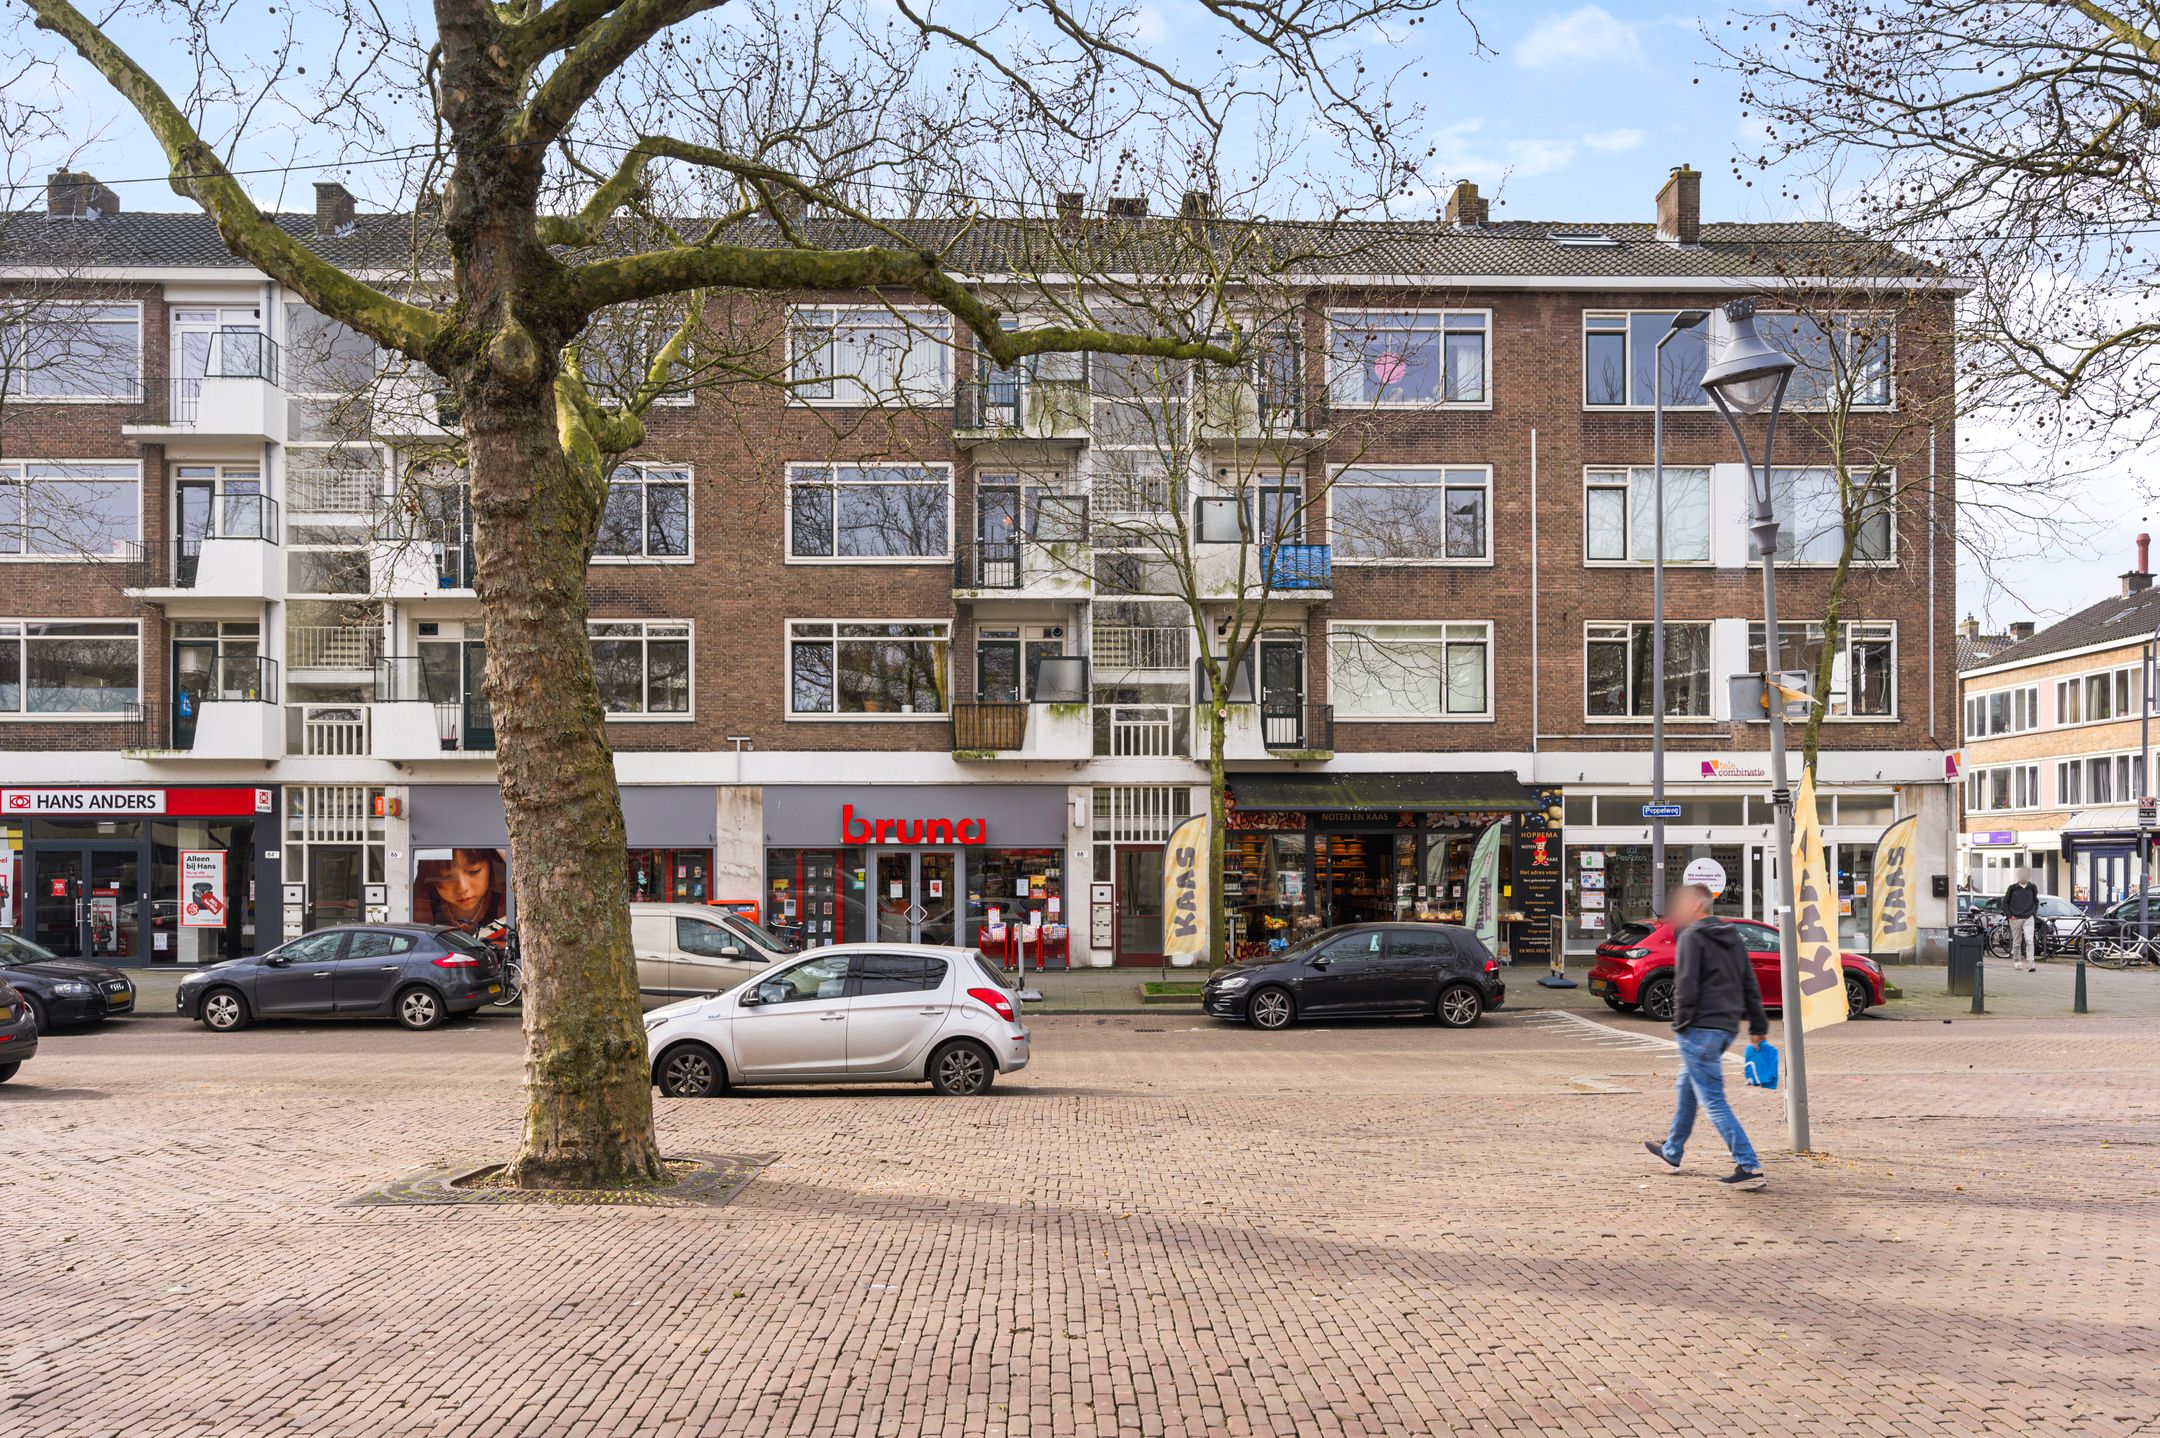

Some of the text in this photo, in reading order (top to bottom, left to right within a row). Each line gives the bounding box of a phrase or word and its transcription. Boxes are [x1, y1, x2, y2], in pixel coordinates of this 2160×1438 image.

[37, 794, 156, 809] HANS ANDERS
[1779, 805, 1788, 815] 17
[842, 804, 987, 845] bruna
[1174, 845, 1197, 938] KAAS
[1881, 845, 1908, 936] KAAS
